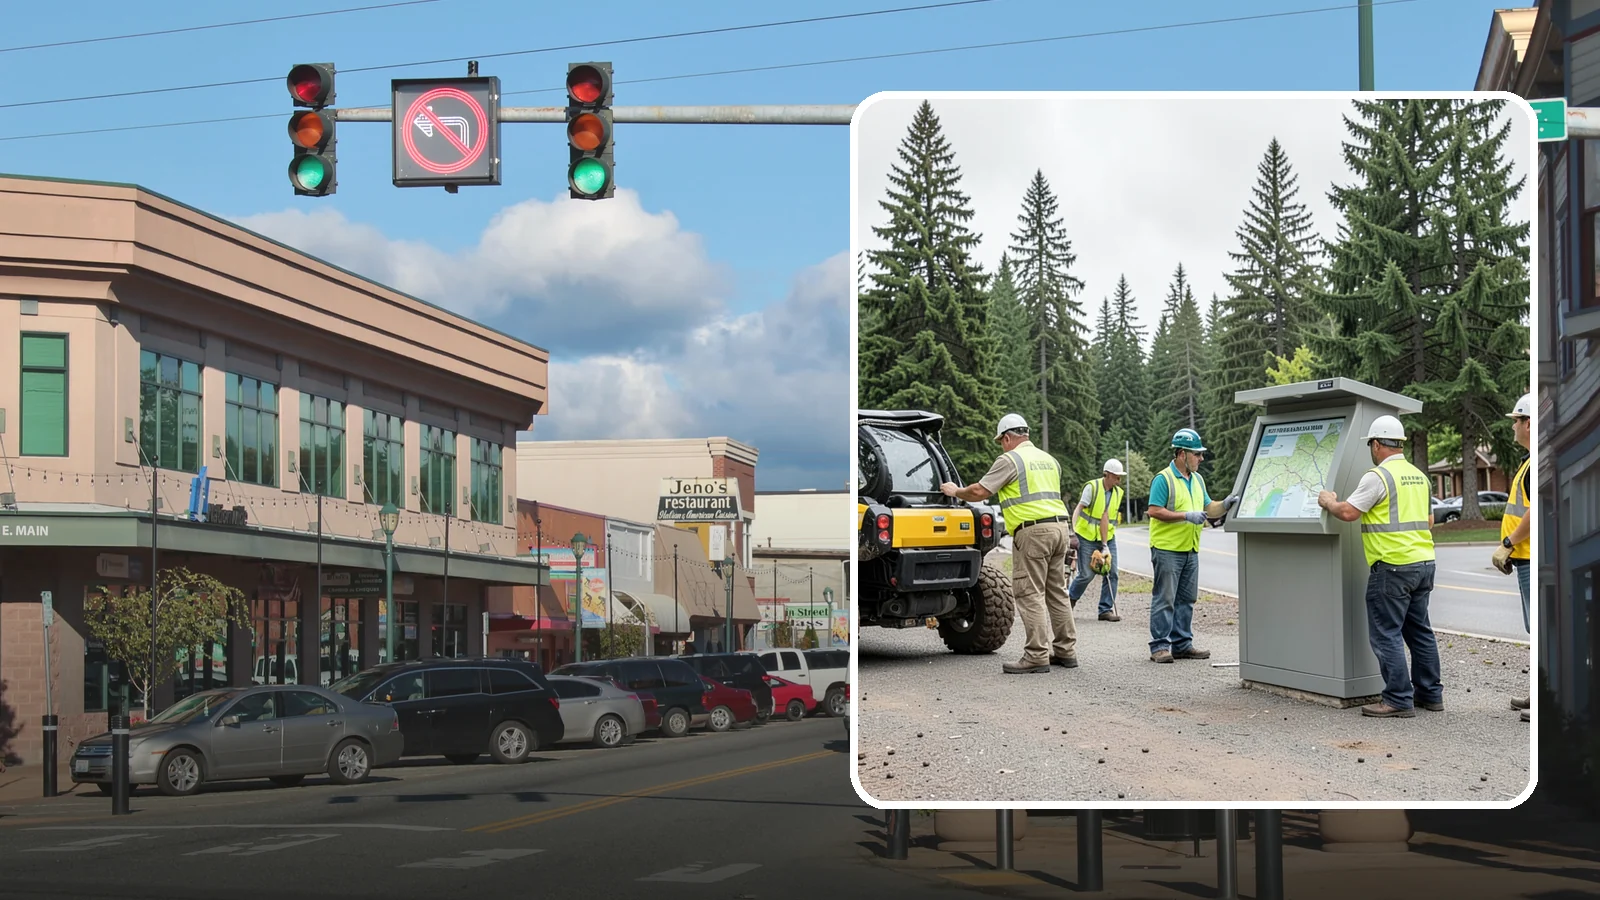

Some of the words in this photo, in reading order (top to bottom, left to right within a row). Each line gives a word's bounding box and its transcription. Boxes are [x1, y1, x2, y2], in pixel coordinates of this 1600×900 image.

[669, 480, 728, 494] Jeno's
[665, 496, 731, 508] restaurant
[2, 525, 13, 536] E.
[15, 525, 49, 536] MAIN
[797, 607, 829, 617] Street
